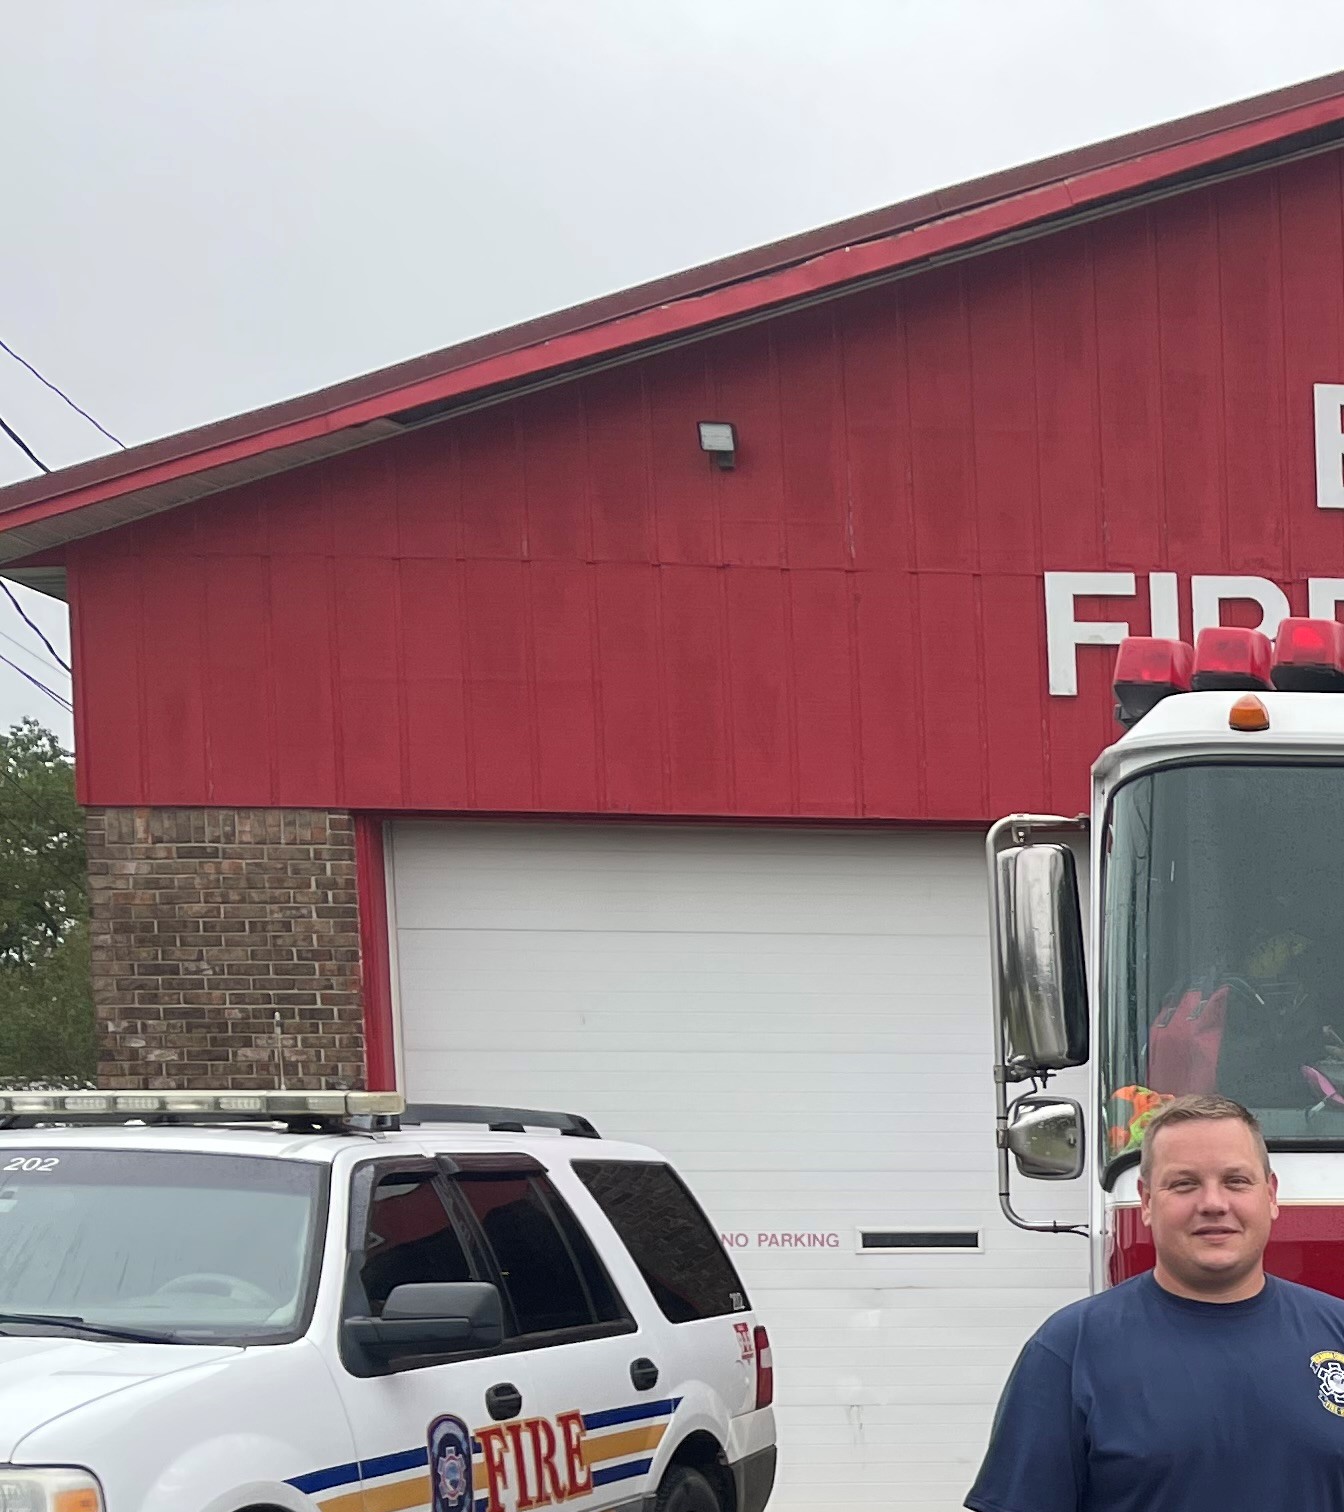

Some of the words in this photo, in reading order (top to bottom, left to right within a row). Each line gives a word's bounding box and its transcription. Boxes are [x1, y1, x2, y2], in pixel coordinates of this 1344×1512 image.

[3, 1157, 60, 1172] 202
[721, 1233, 749, 1248] NO
[757, 1233, 840, 1248] PARKING
